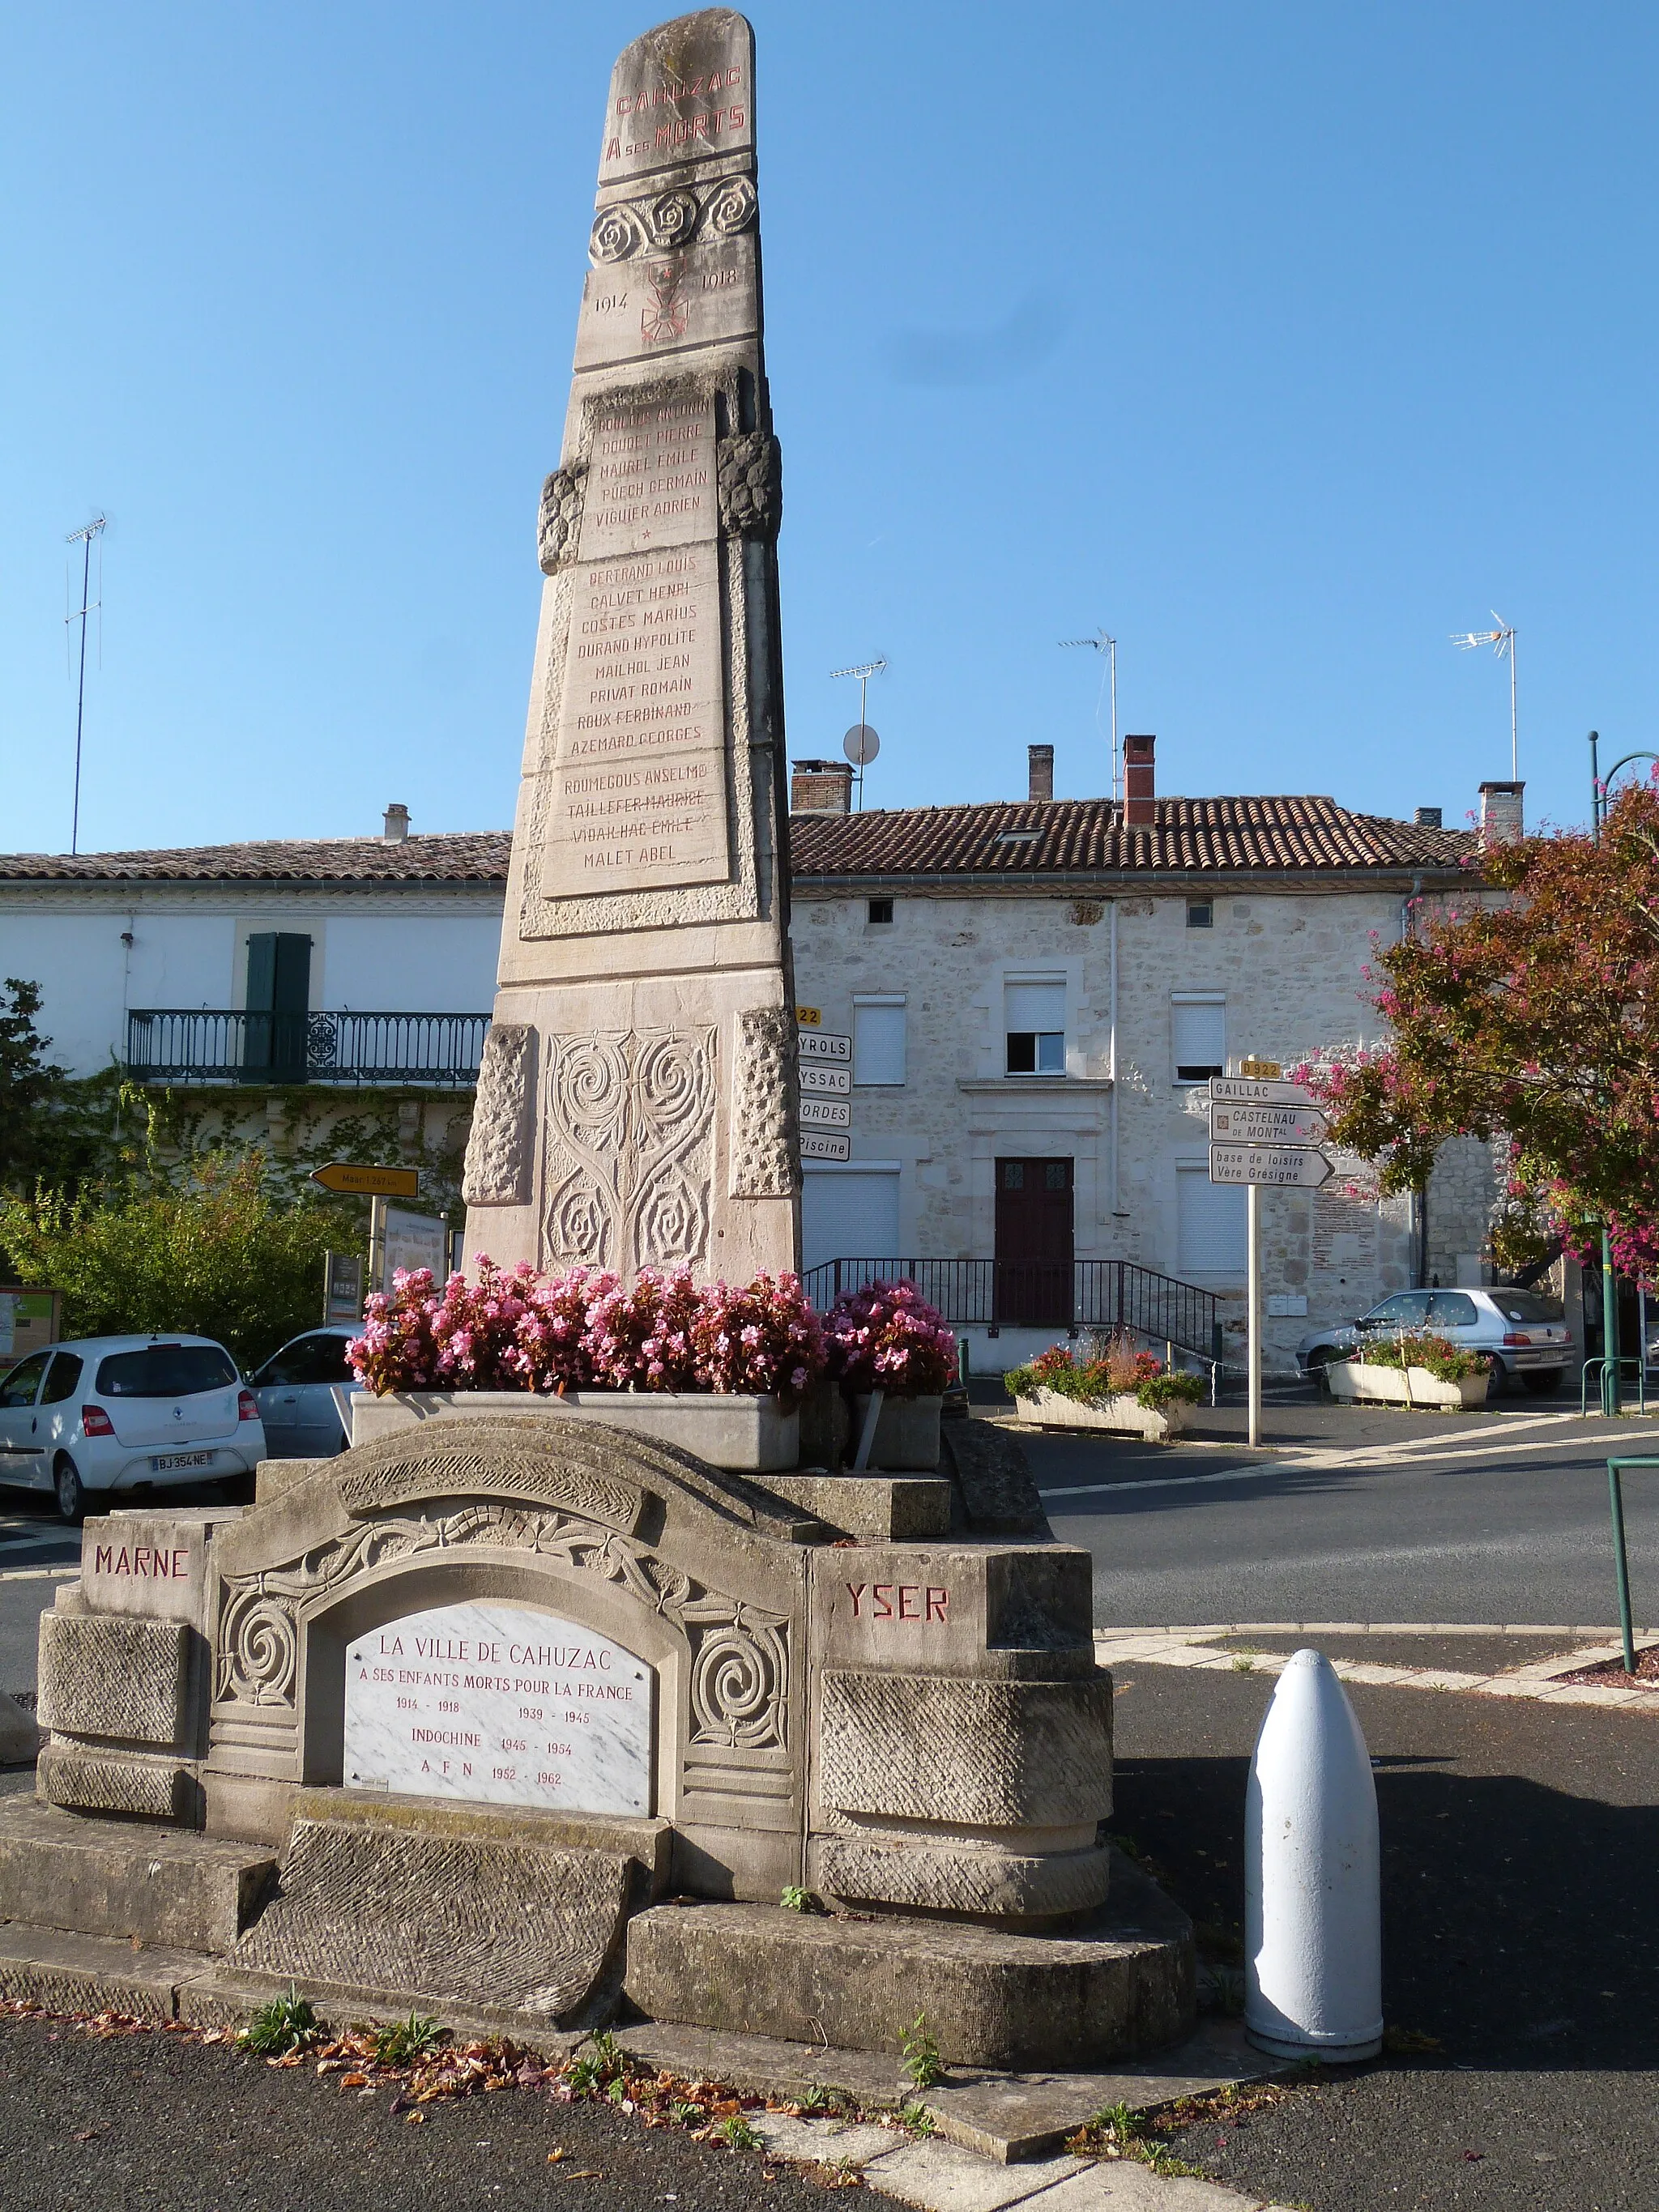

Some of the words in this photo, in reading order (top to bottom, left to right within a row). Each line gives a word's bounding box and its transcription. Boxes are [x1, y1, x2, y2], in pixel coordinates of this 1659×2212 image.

[616, 66, 742, 116] CAHUZAC
[606, 136, 621, 162] A
[625, 142, 650, 156] SES
[655, 104, 745, 149] MORTS
[702, 268, 737, 289] 1918
[595, 292, 628, 316] 1914
[657, 399, 710, 422] ANTONIN
[657, 424, 702, 444] PIERRE
[600, 458, 652, 479] MAUREL
[603, 482, 643, 501] PUECH
[650, 470, 707, 493] GERMAIN
[596, 505, 649, 527] VIGUIER
[654, 496, 701, 516] ADRIEN
[590, 563, 653, 586] BERTRAND
[659, 554, 697, 574] LOUIS
[591, 589, 644, 609] CALVET
[650, 582, 689, 600] HENRI
[582, 615, 636, 633] COSTES
[643, 603, 697, 626] MARIUS
[578, 637, 629, 658] DURAND
[634, 628, 697, 650] HYPOLITE
[596, 661, 651, 680] MAILHOL
[657, 654, 690, 671] JEAN
[590, 686, 635, 704] PRIVAT
[642, 675, 693, 697] ROMAIN
[578, 714, 611, 730] ROUX
[616, 702, 693, 724] FERDINAND
[572, 735, 633, 755] AZEMARD
[640, 726, 702, 744] GEORGES
[565, 772, 640, 795] ROUMEGOUS
[568, 799, 642, 818] TAILLEFER
[646, 788, 705, 810] MAURICE
[574, 823, 646, 843] VIDAILHAC
[584, 850, 633, 867] MALET
[639, 846, 676, 863] ABEL
[800, 1009, 817, 1023] 22
[800, 1038, 846, 1055] YROLS
[800, 1071, 846, 1088] YSSAC
[1243, 1063, 1249, 1074] D
[1255, 1064, 1277, 1076] 922
[1216, 1084, 1269, 1097] GAILLAC
[800, 1105, 847, 1120] ORDES
[1233, 1110, 1296, 1124] CASTELNAU
[1217, 1151, 1243, 1162] base
[1249, 1153, 1262, 1164] de
[1269, 1154, 1303, 1166] loisirs
[343, 1174, 363, 1183] Maar
[1218, 1166, 1242, 1177] Vère
[1249, 1168, 1299, 1183] Grésigne
[95, 1545, 189, 1578] MARNE
[846, 1582, 949, 1624] YSER
[380, 1634, 404, 1656] LA
[416, 1638, 470, 1661] VILLE
[478, 1641, 501, 1664] DE
[509, 1644, 612, 1671] CAHUZAC
[359, 1668, 369, 1680] A
[373, 1669, 394, 1682] SES
[399, 1671, 459, 1687] ENFANTS
[463, 1674, 510, 1692] MORTS
[514, 1678, 550, 1694] POUR
[555, 1682, 572, 1696] LA
[578, 1683, 633, 1700] FRANCE
[396, 1696, 418, 1710] 1914
[438, 1700, 460, 1713] 1918
[518, 1707, 544, 1720] 1939
[565, 1711, 591, 1724] 1945
[412, 1728, 481, 1747] INDOCHINE
[501, 1738, 527, 1751] 1945
[548, 1742, 572, 1755] 1954
[421, 1759, 430, 1772] A
[443, 1761, 450, 1773] F
[463, 1762, 472, 1776] N
[537, 1771, 561, 1784] 1962
